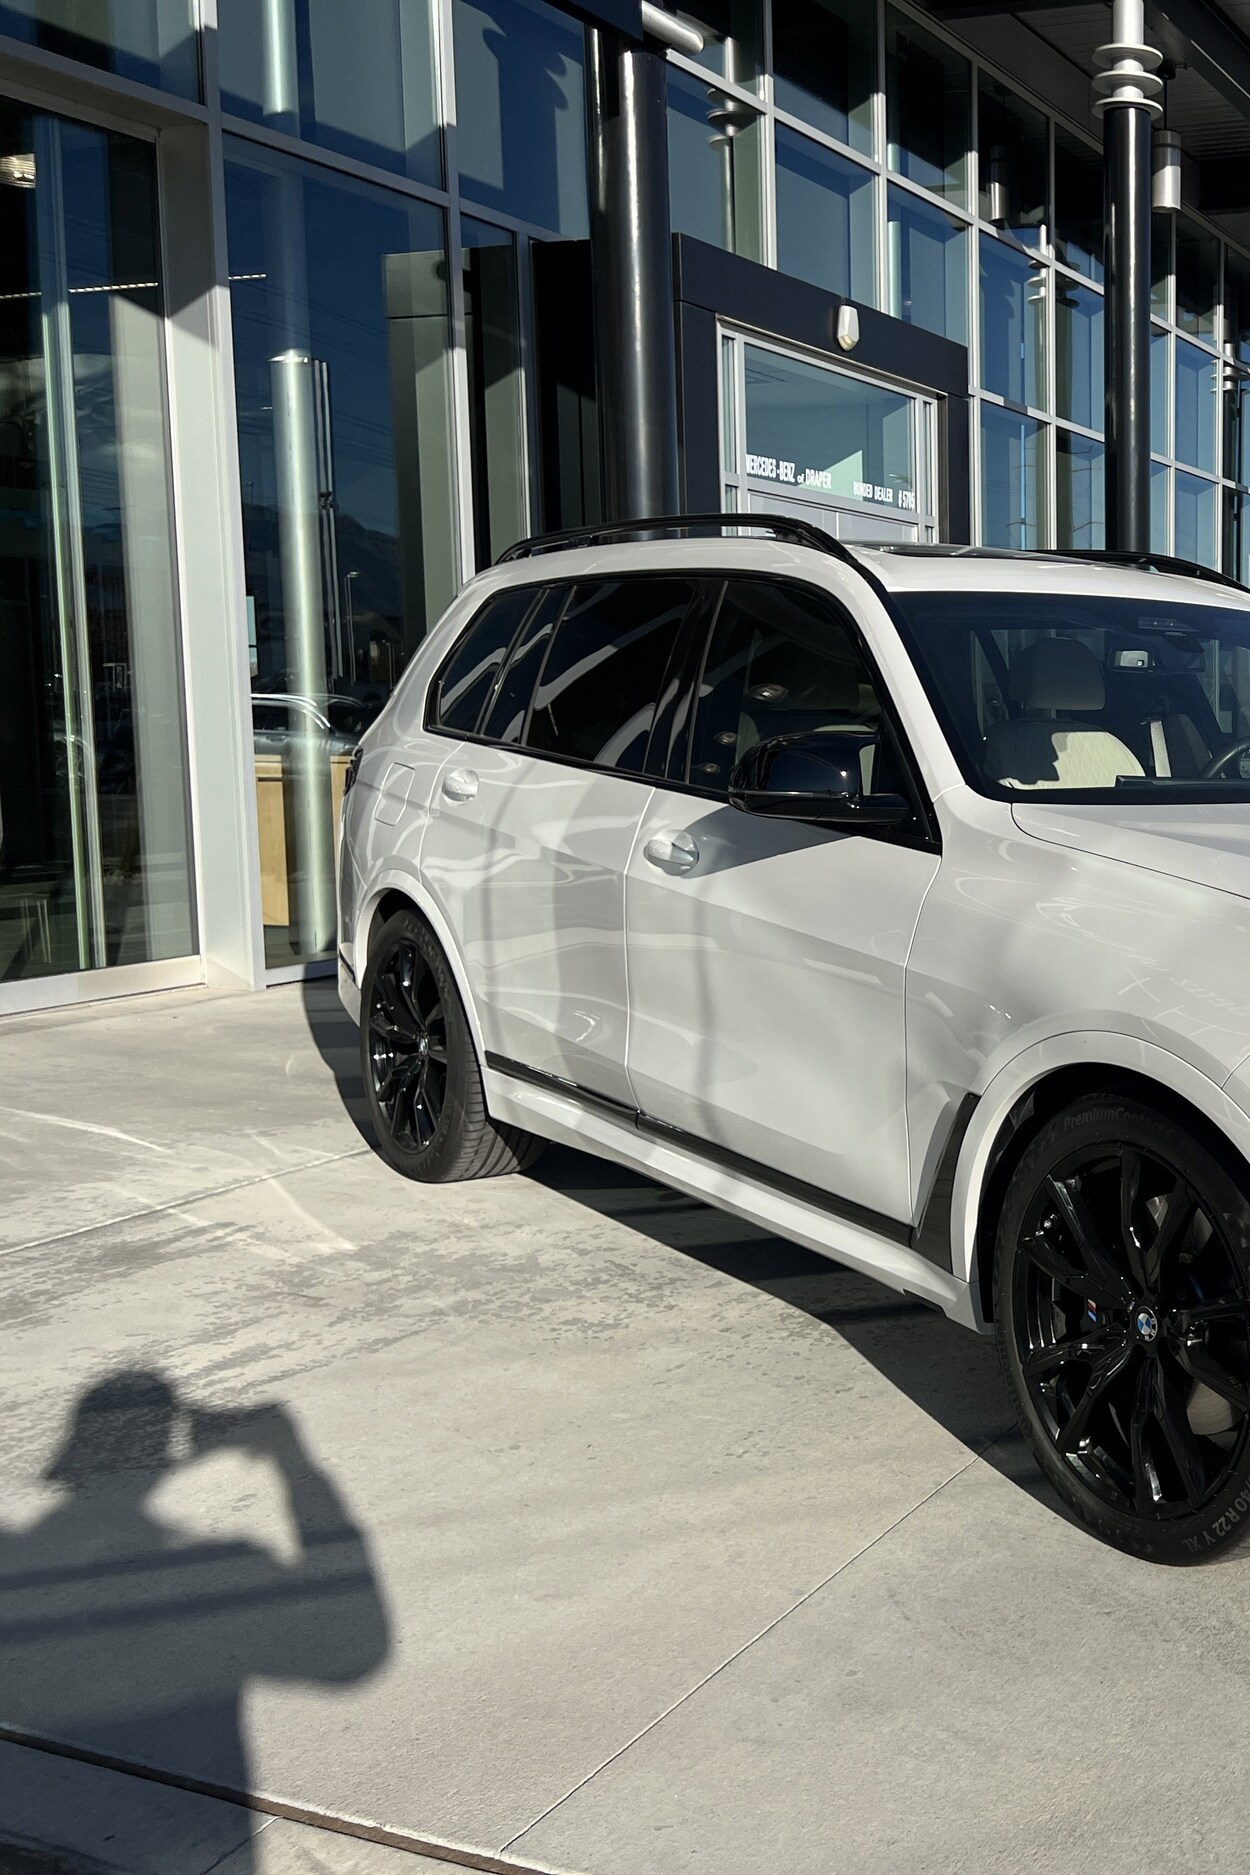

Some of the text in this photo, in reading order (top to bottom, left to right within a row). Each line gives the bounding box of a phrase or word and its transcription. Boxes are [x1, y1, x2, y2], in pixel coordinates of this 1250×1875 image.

[797, 473, 804, 484] of
[805, 468, 831, 489] DRAPER
[874, 485, 893, 503] DEALER
[1182, 1536, 1202, 1553] XL
